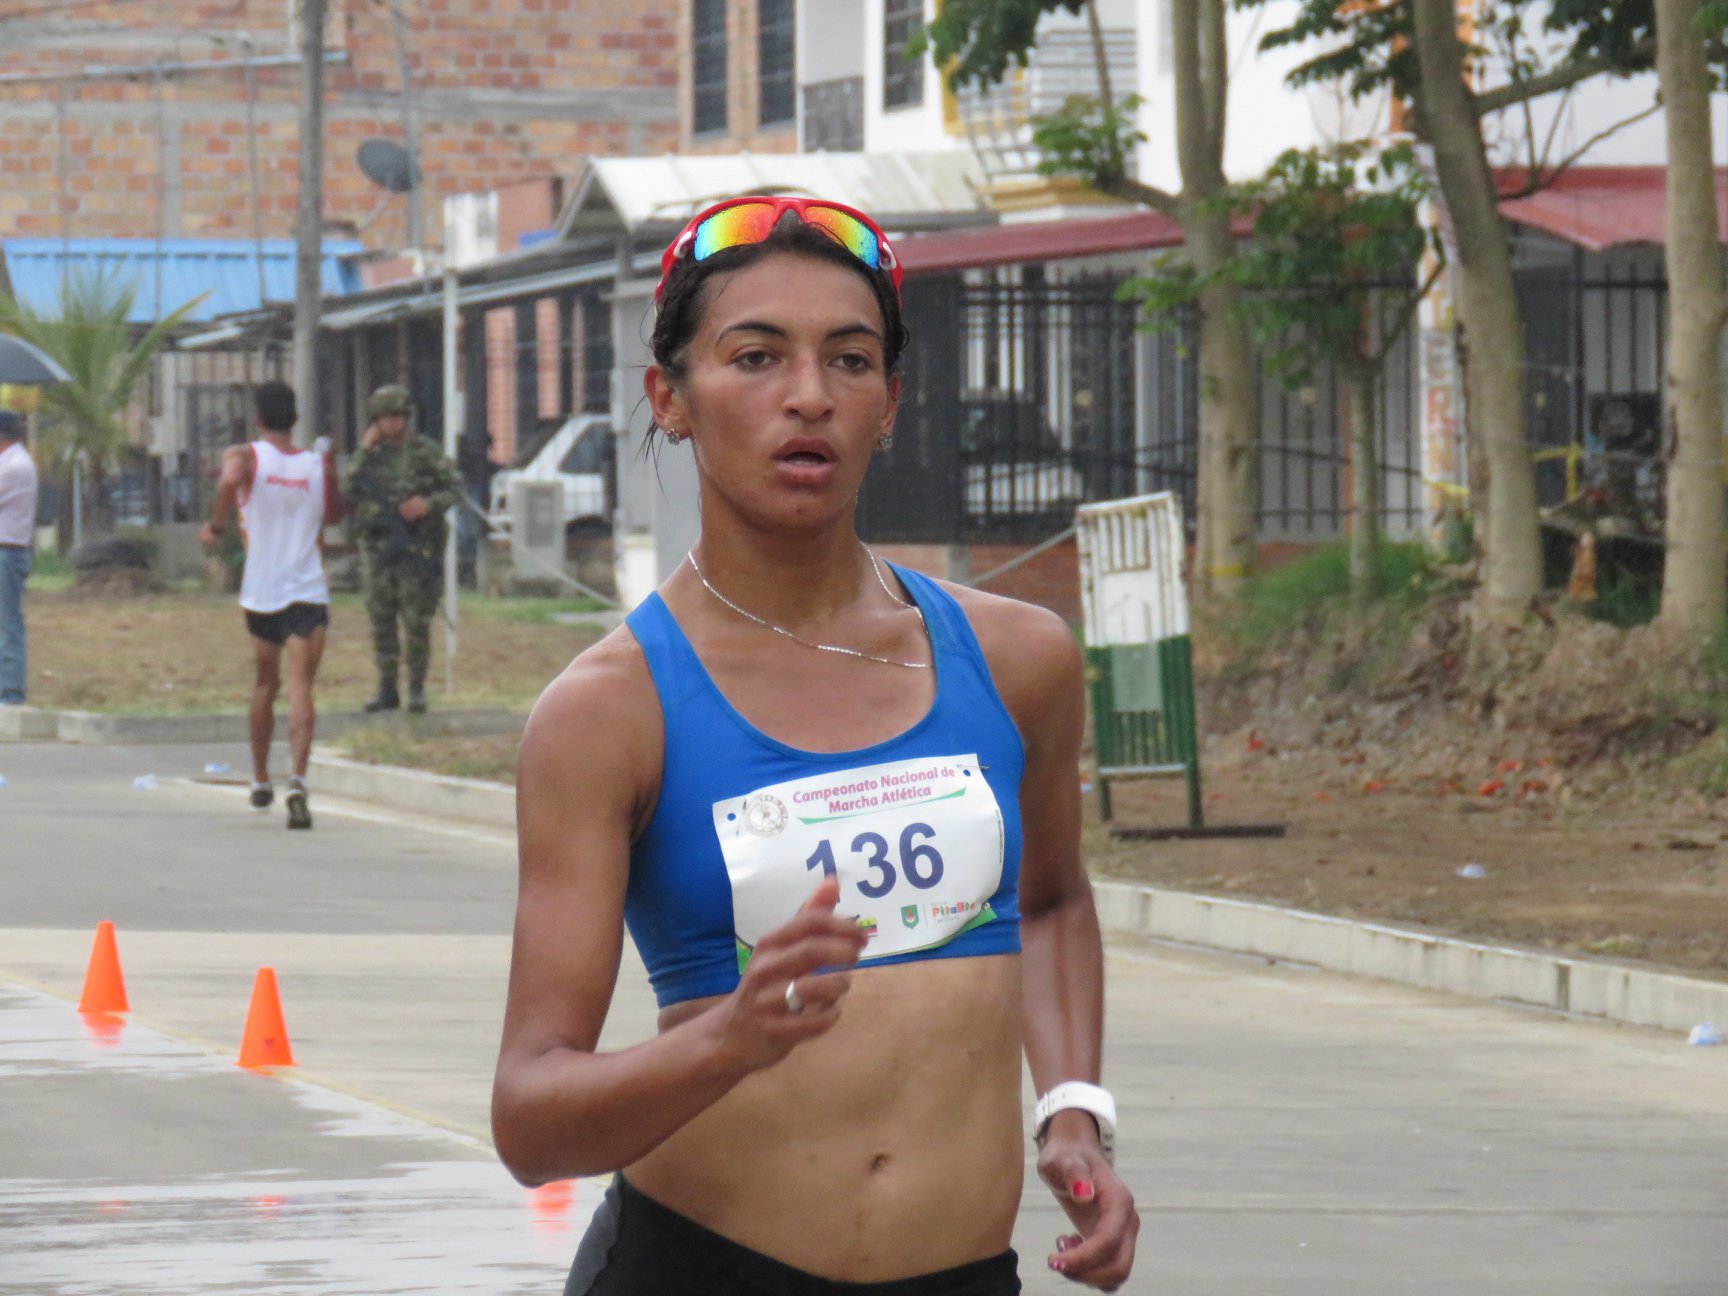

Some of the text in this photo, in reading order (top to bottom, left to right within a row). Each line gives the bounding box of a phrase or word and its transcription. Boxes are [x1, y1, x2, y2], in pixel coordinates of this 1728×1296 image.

[792, 766, 956, 804] Campeonato Nacional de
[829, 786, 932, 814] Marcha Atlética
[806, 822, 944, 903] 136
